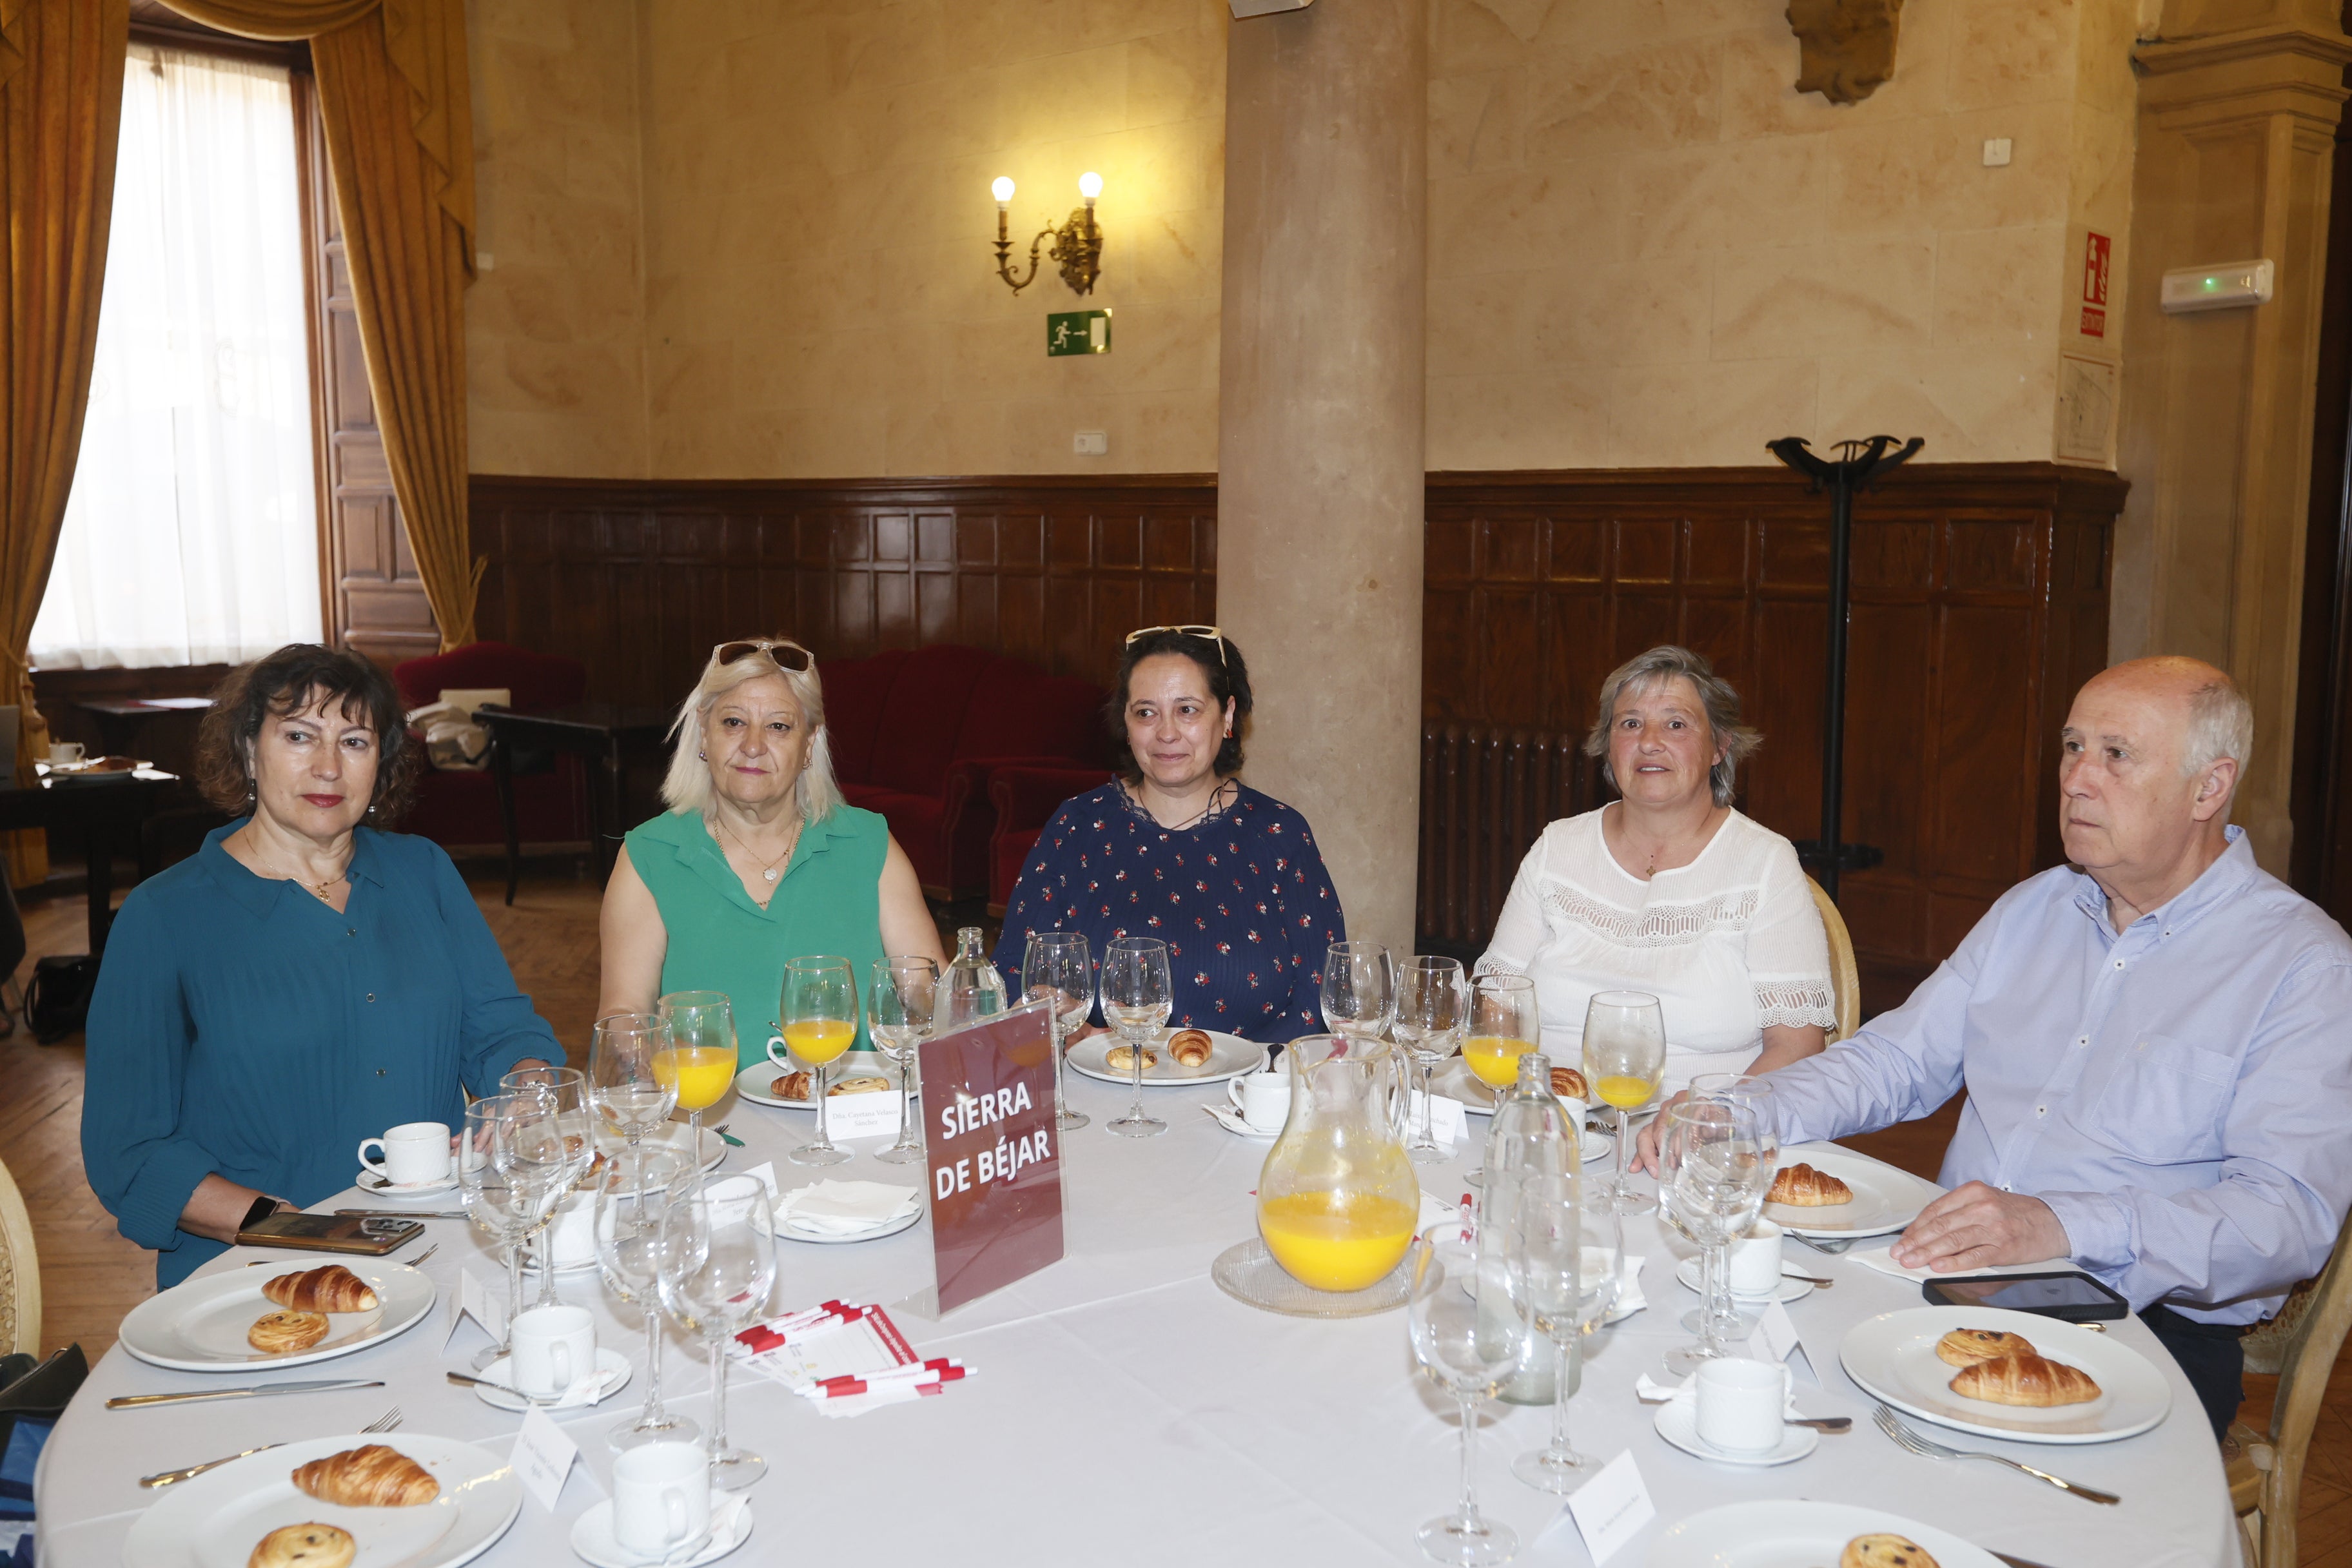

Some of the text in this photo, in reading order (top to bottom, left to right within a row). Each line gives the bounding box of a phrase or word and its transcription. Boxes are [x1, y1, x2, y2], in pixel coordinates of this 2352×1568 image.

[848, 1111, 875, 1119] Cayetana
[941, 1081, 1032, 1140] SIERRA
[936, 1129, 1051, 1201] DE BÉJAR
